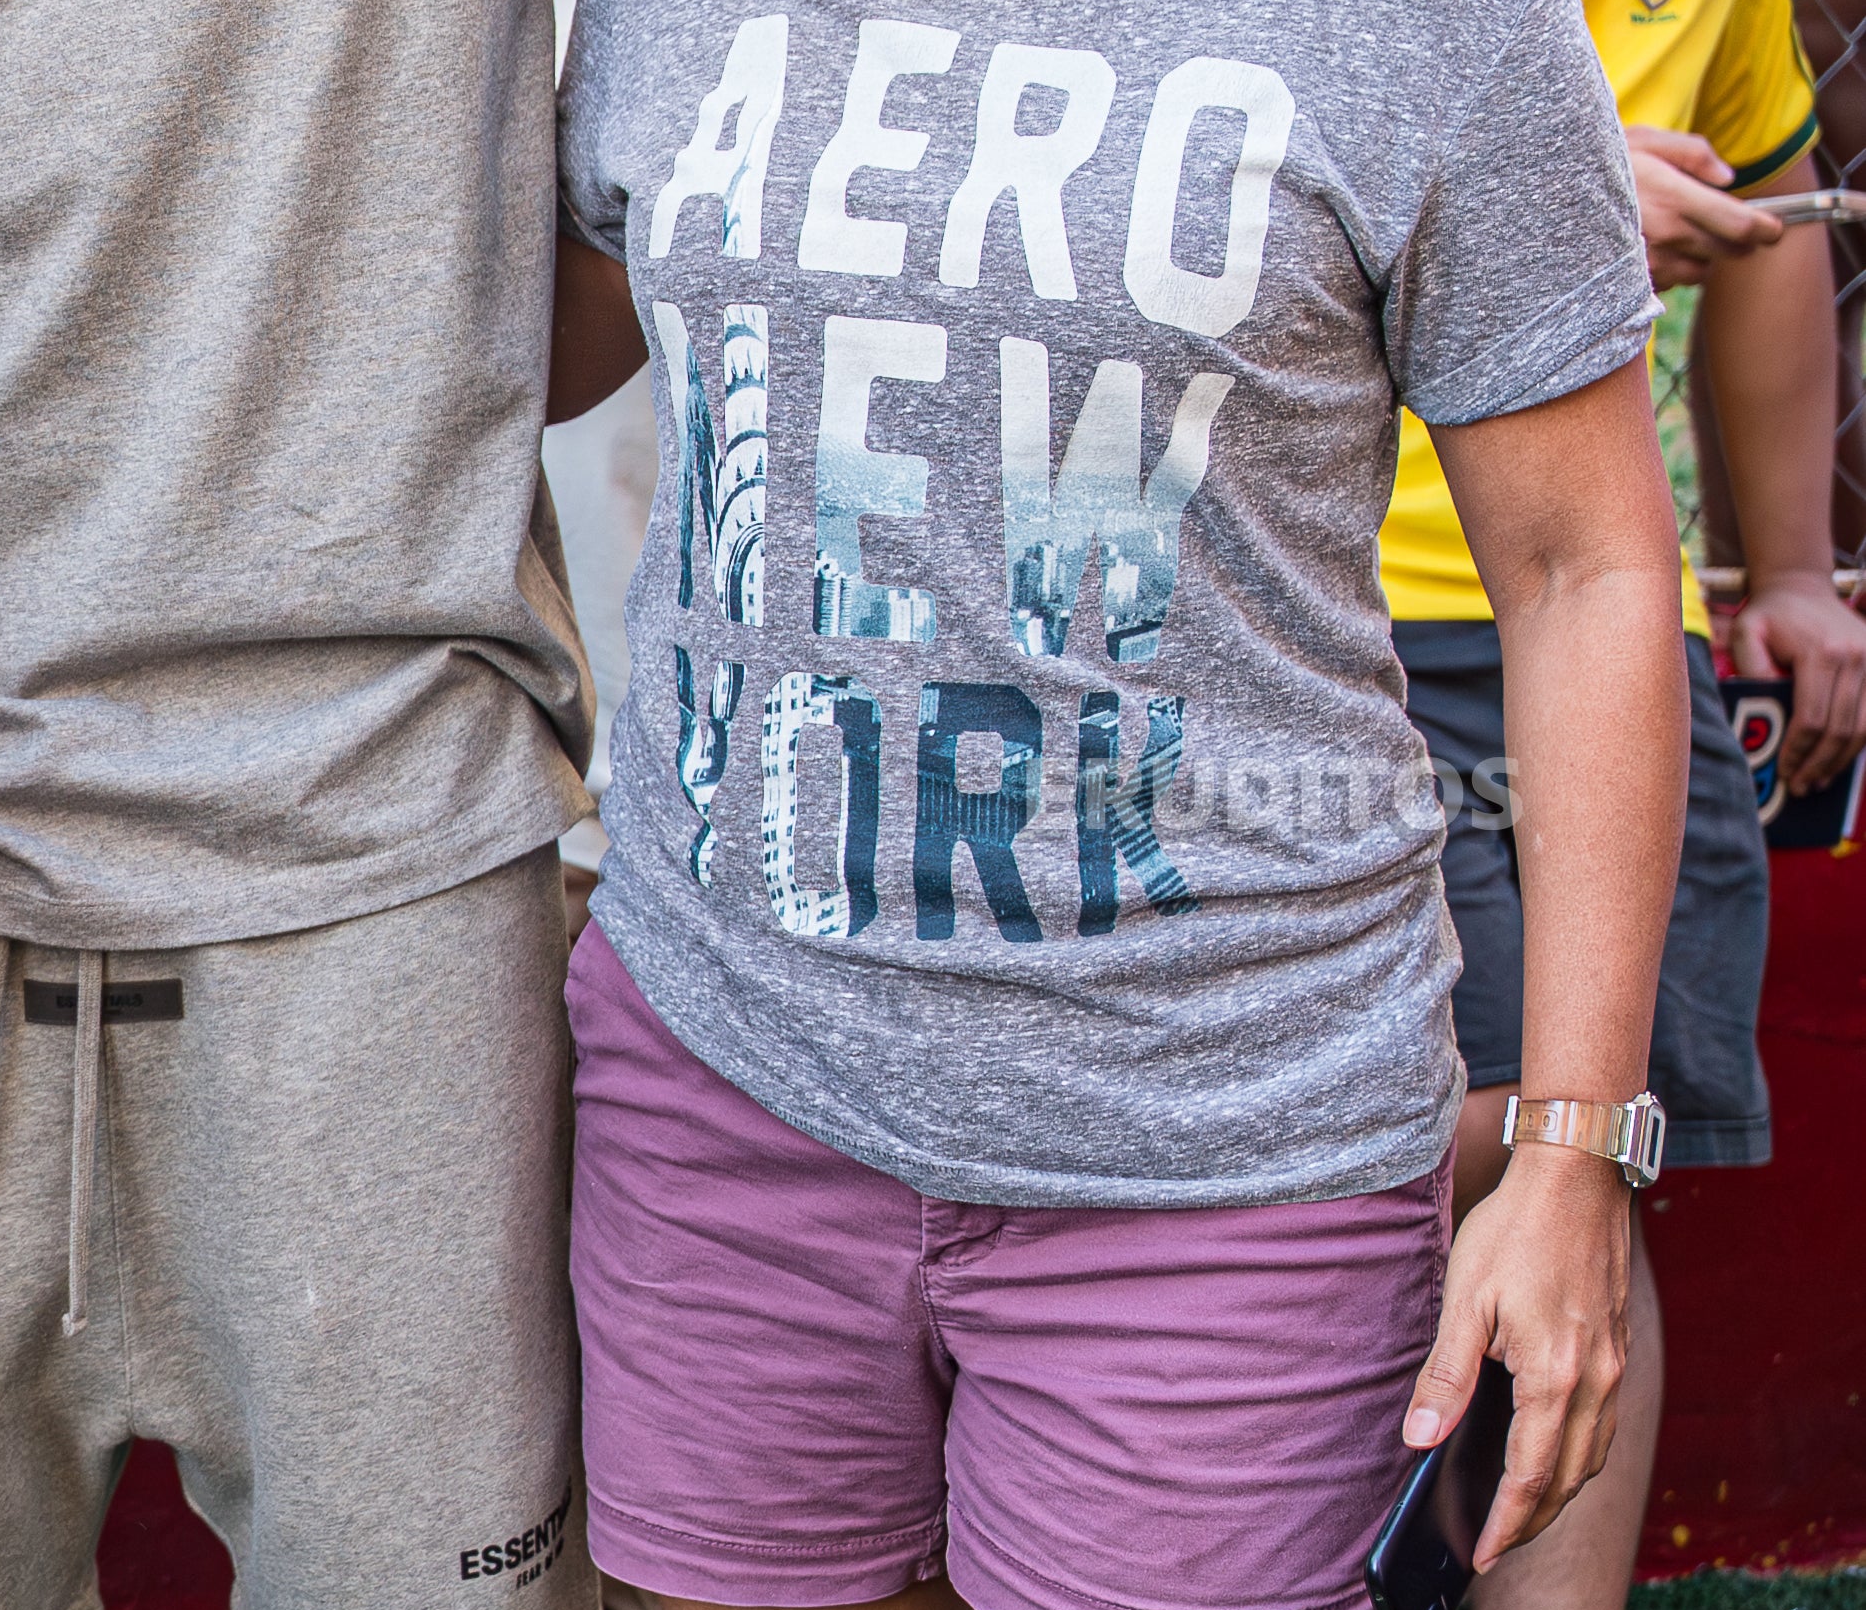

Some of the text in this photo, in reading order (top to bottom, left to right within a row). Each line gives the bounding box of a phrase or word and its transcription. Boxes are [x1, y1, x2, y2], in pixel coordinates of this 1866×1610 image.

[648, 13, 1296, 340] AERO
[651, 299, 1235, 664] NEW
[673, 643, 1202, 943] YORK
